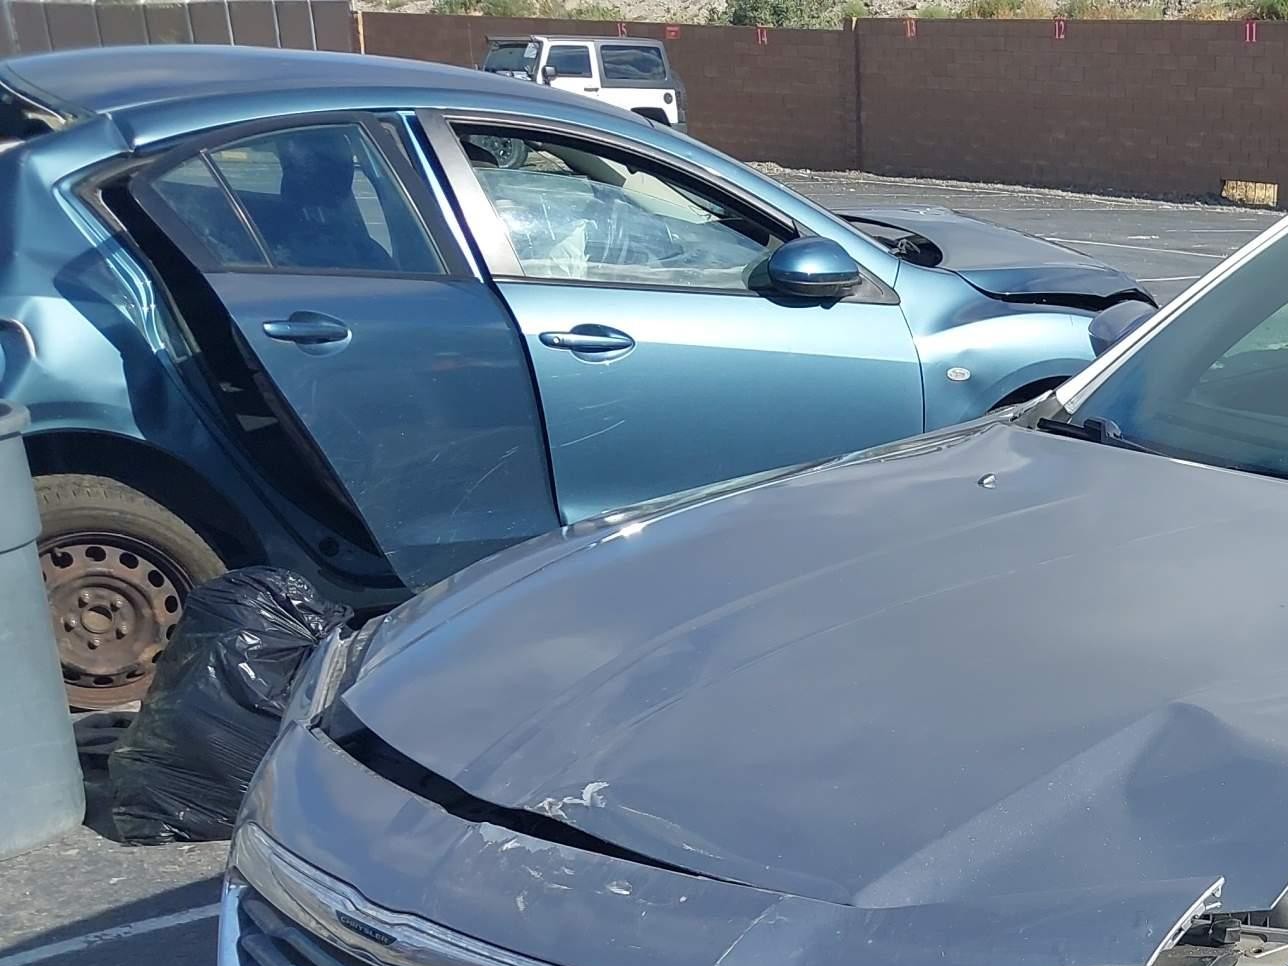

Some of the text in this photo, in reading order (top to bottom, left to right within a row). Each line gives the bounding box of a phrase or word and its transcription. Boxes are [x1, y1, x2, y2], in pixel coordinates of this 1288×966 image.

[756, 28, 769, 45] 14
[1054, 21, 1066, 39] 12
[1244, 23, 1258, 42] 11
[340, 916, 390, 944] CHRYSLER
